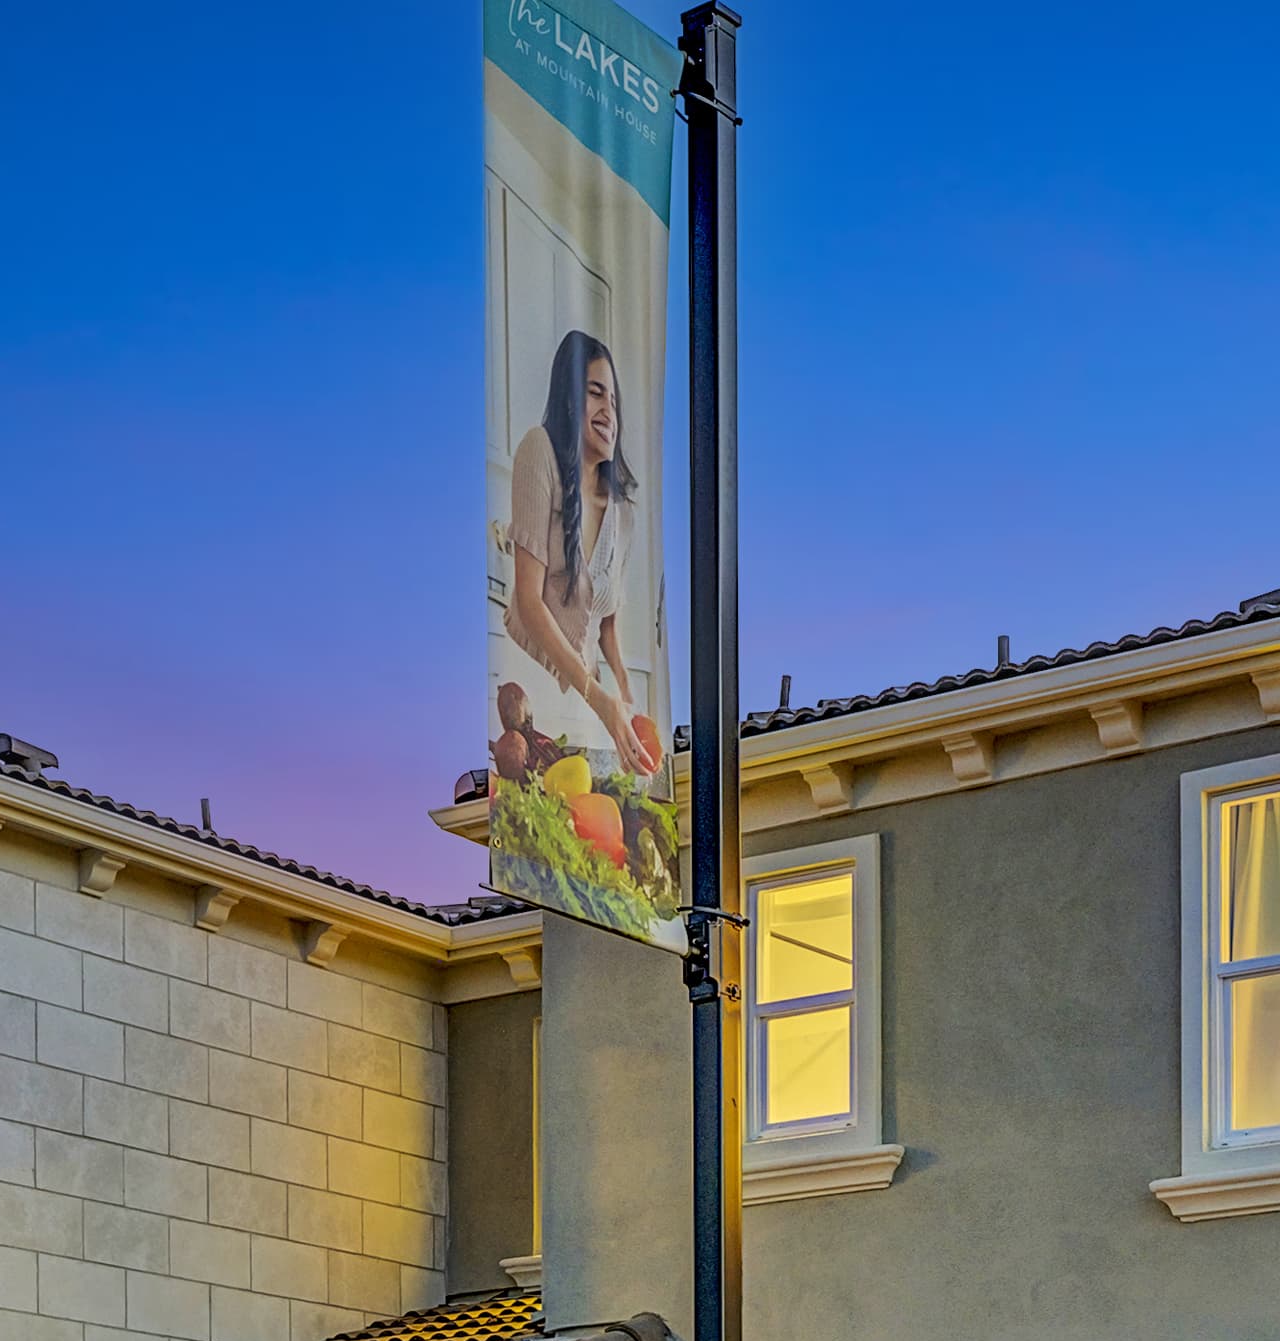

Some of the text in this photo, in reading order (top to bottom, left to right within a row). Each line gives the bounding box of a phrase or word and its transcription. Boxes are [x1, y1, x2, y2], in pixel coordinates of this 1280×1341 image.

[515, 38, 657, 145] AT MOUNTAIN HOUSE
[555, 13, 660, 114] LAKES
